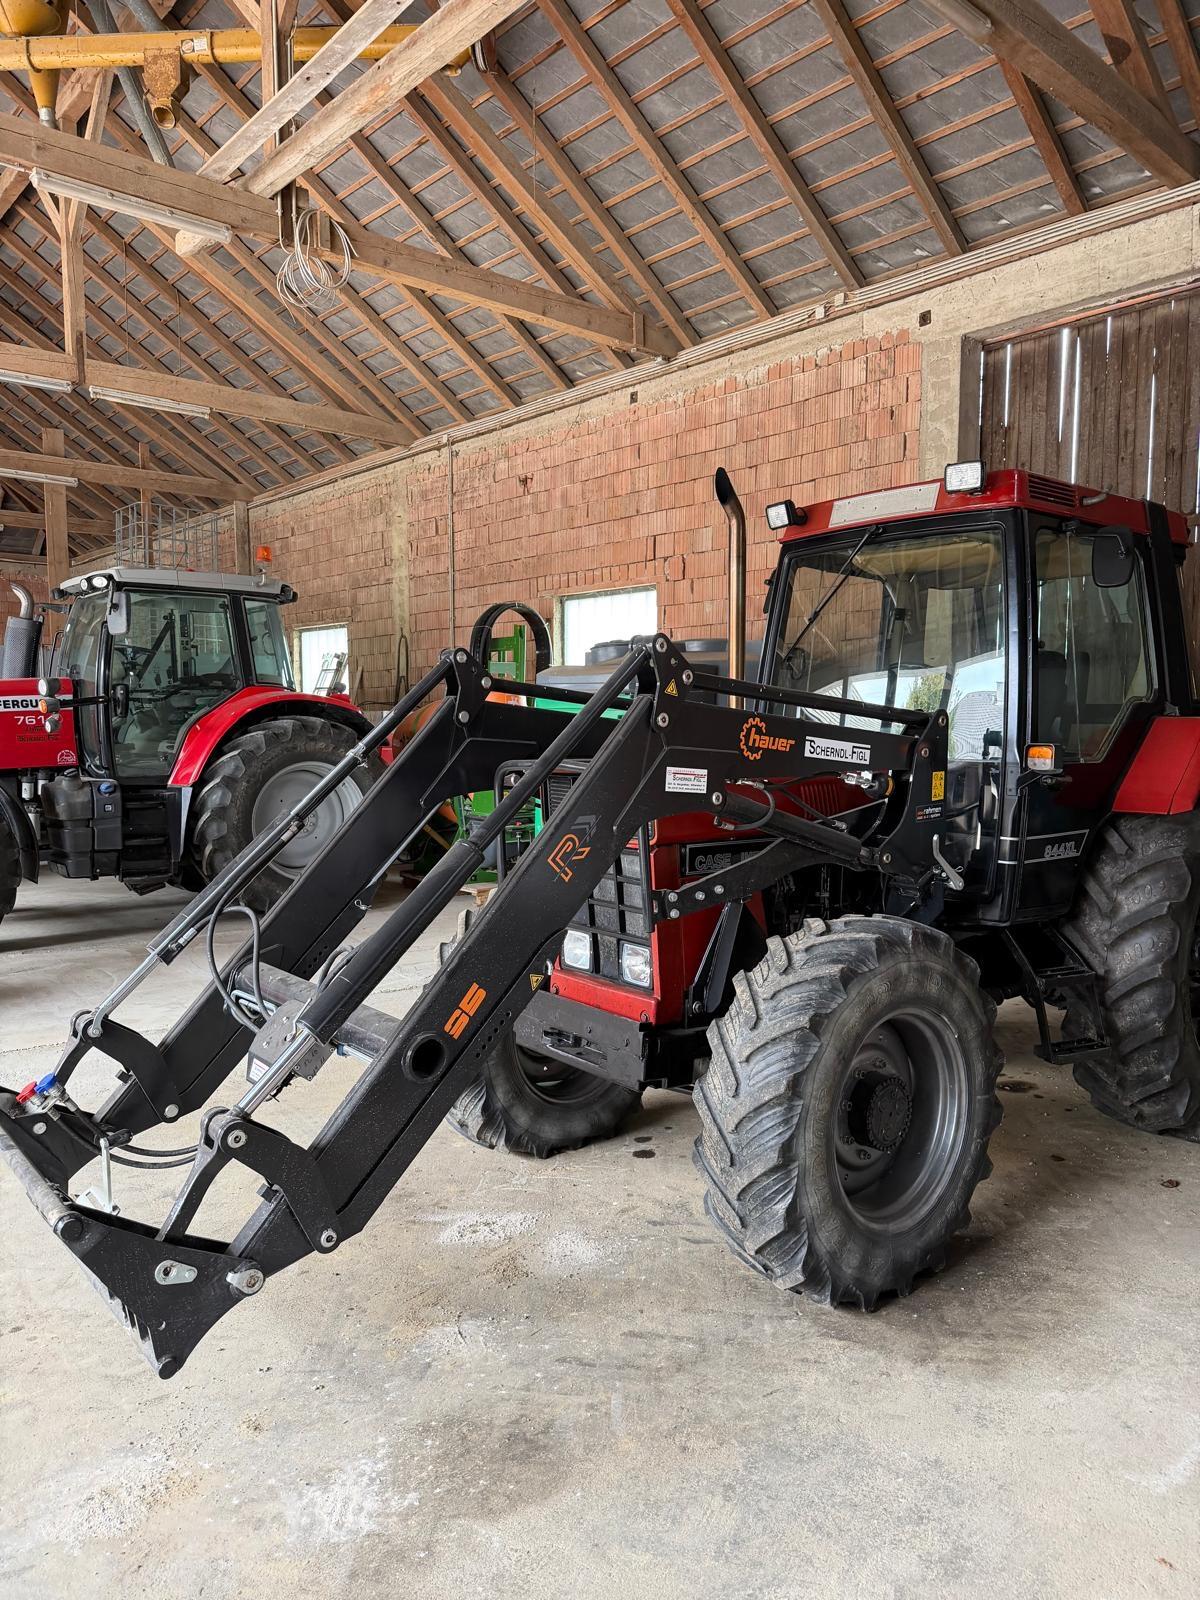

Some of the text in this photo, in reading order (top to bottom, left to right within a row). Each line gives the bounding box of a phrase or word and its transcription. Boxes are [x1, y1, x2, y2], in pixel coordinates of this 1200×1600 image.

[14, 714, 53, 726] 761
[748, 727, 795, 752] hauer
[809, 740, 868, 762] SCHERNDL-FIGL
[694, 852, 732, 871] CASE
